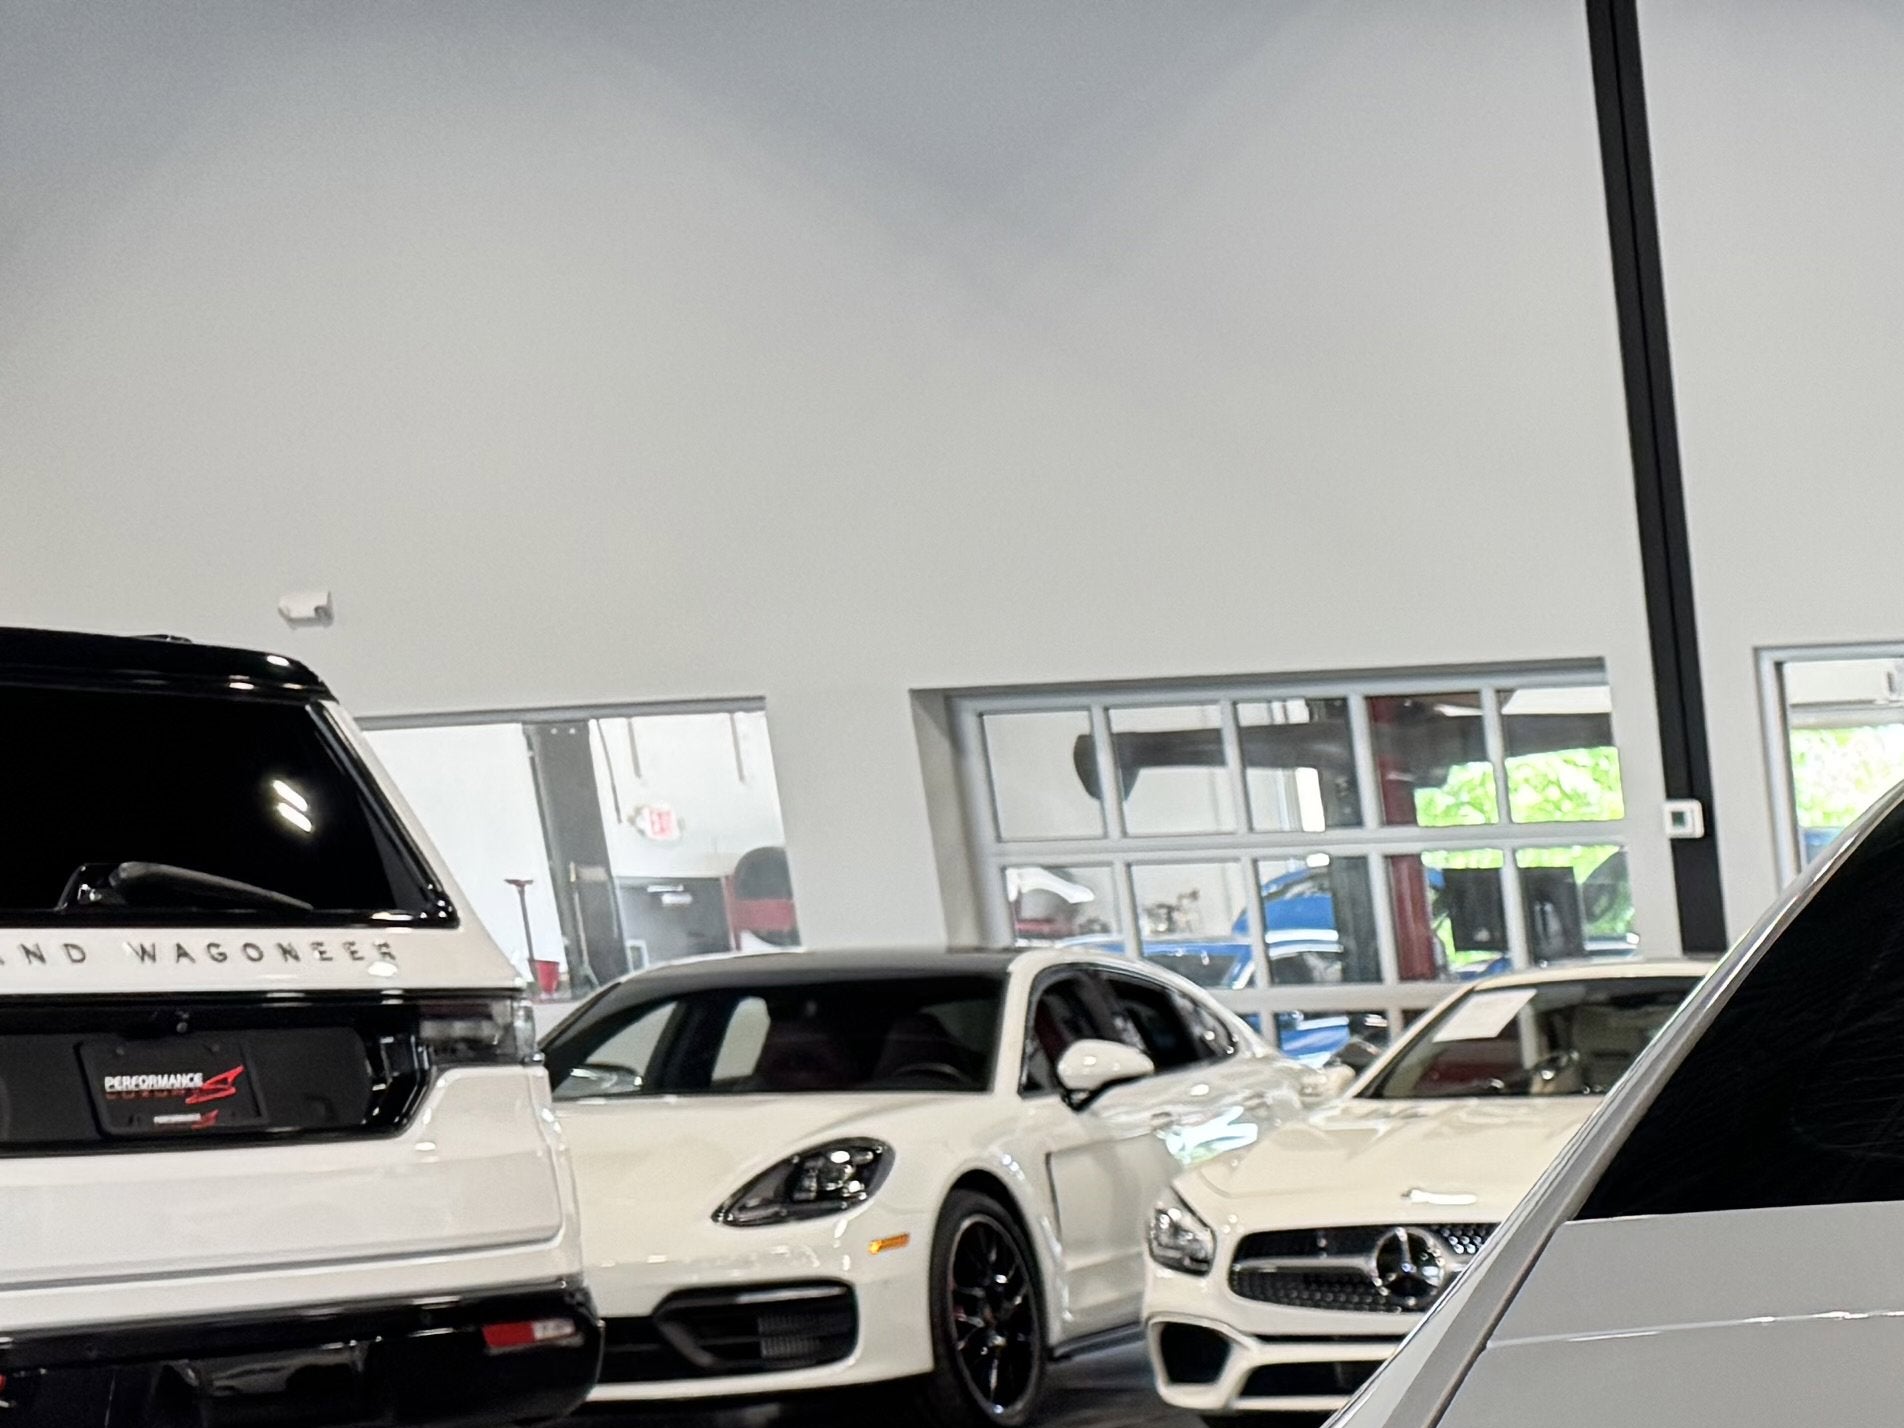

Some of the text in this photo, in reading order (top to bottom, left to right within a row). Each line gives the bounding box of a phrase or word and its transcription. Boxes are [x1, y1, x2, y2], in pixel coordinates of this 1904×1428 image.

[0, 941, 397, 965] ND WAGONEER
[104, 1072, 203, 1092] PERFORMANCE
